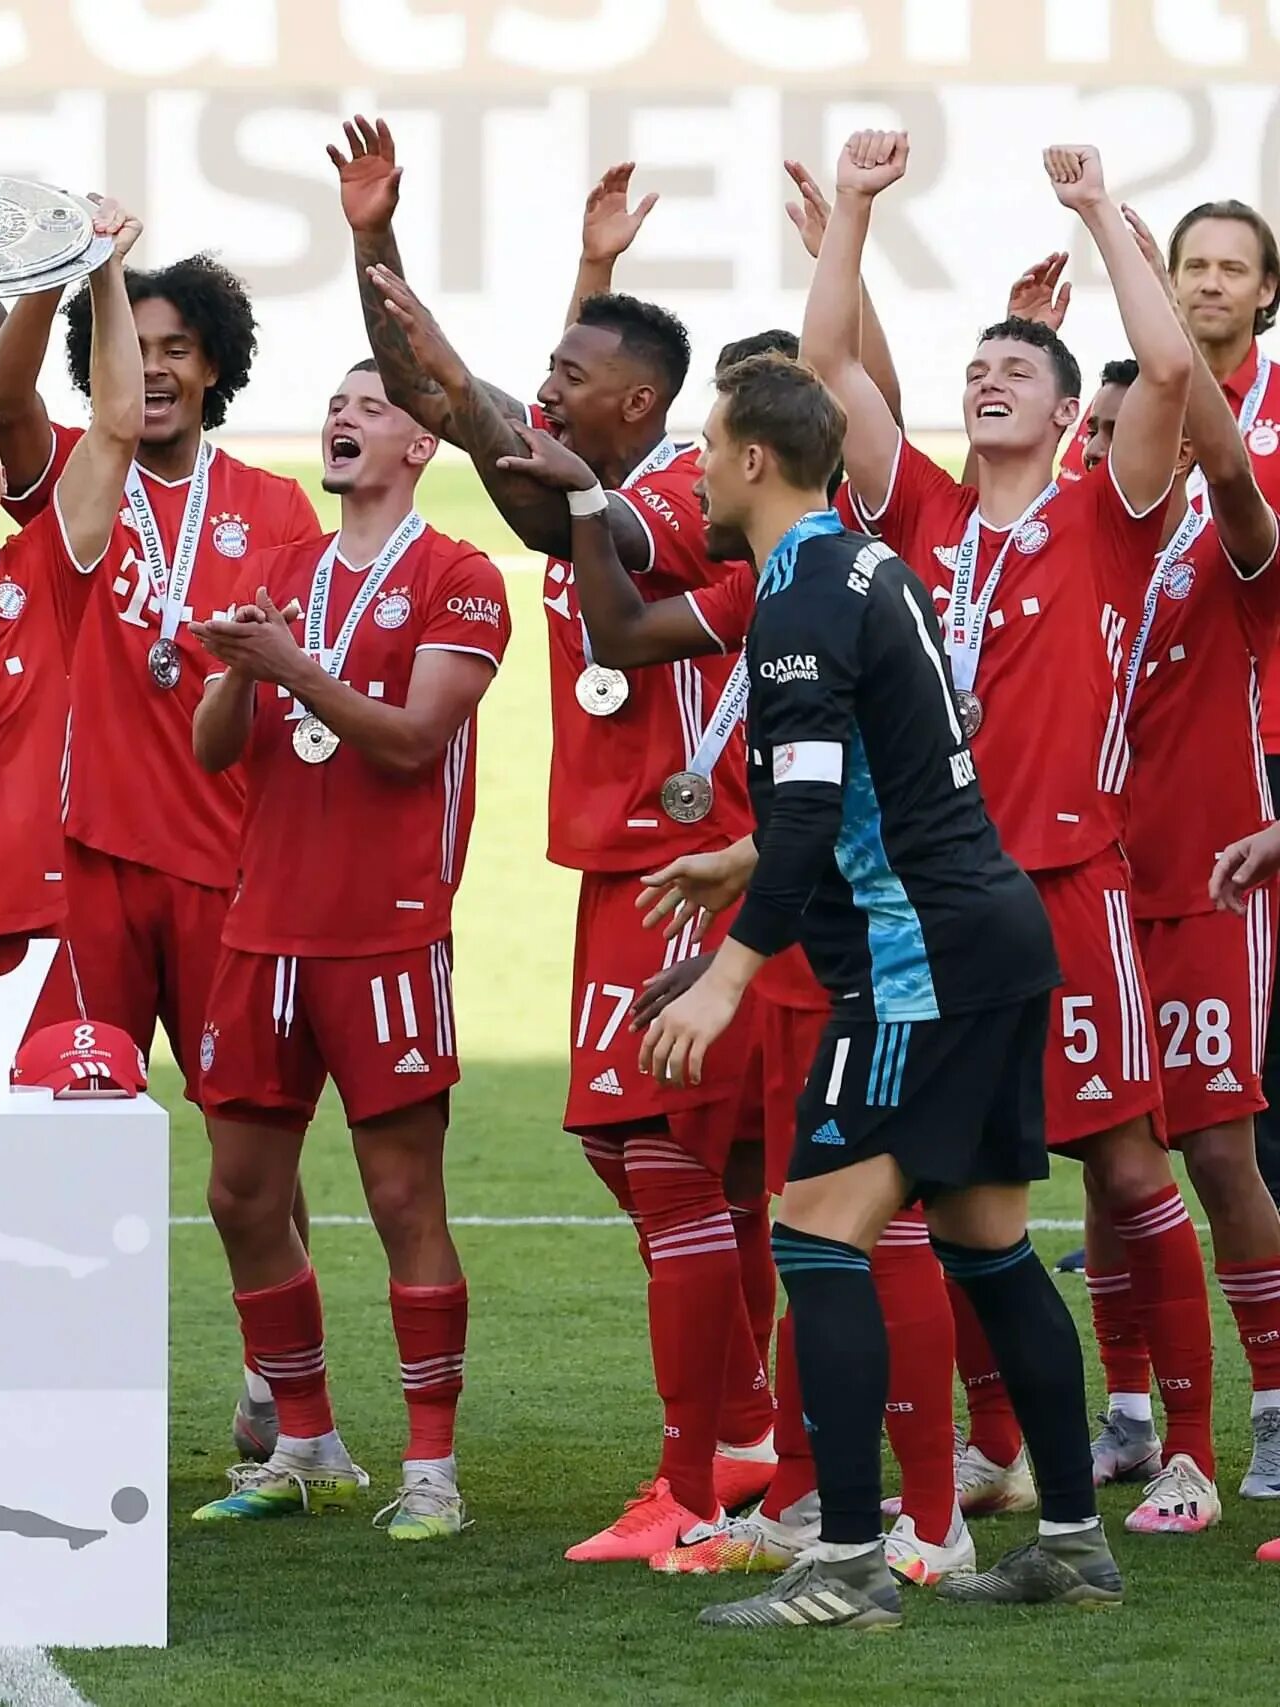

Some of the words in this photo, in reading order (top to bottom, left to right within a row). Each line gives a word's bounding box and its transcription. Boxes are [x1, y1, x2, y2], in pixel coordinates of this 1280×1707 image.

[131, 489, 164, 579] BUNDESLIGA
[173, 537, 193, 600] DEUTSCHER
[954, 540, 975, 627] BUNDESLIGA
[309, 567, 329, 650] BUNDESLIGA
[328, 611, 358, 675] DEUTSCHER
[356, 526, 413, 610] FUSSBALLMEISTER
[446, 597, 502, 619] QATAR
[970, 583, 994, 650] DEUTSCHER
[759, 654, 818, 680] QATAR
[777, 670, 819, 684] AIRWAYS
[370, 972, 418, 1044] 11
[576, 981, 635, 1052] 17
[73, 1023, 96, 1050] 8
[1062, 995, 1098, 1063] 5
[1159, 998, 1232, 1068] 28
[394, 1063, 430, 1073] adidas
[825, 1036, 851, 1106] 1
[589, 1081, 623, 1096] adidas
[1076, 1090, 1113, 1101] adidas
[1205, 1081, 1244, 1093] adidas
[811, 1133, 846, 1146] adidas
[1248, 1330, 1280, 1345] FCB
[1159, 1378, 1192, 1391] FCB
[885, 1401, 914, 1413] CB
[663, 1425, 680, 1439] CB
[289, 1477, 337, 1488] NMESIS
